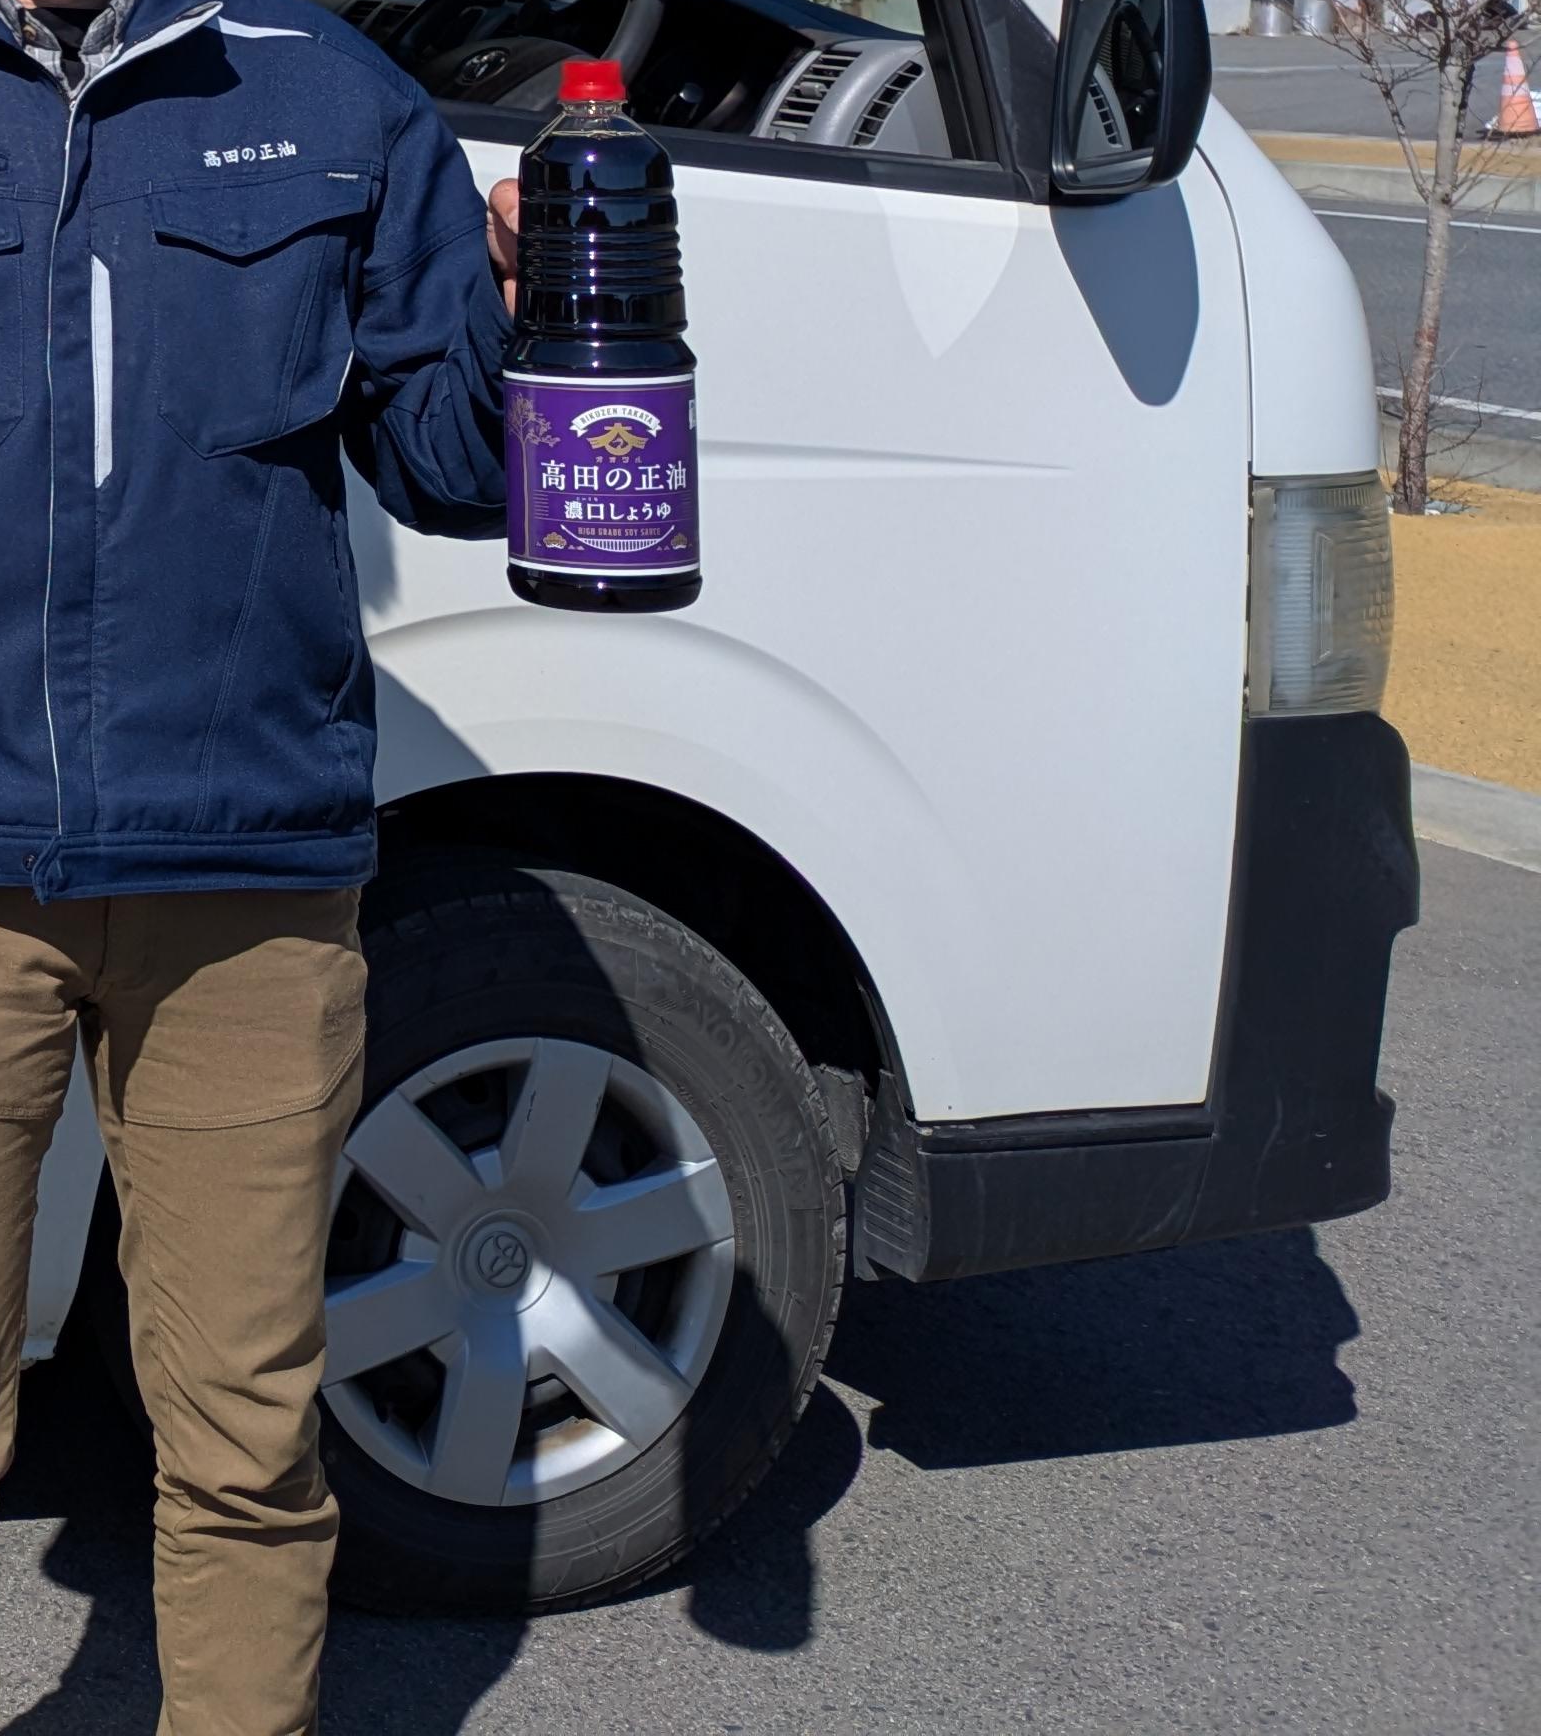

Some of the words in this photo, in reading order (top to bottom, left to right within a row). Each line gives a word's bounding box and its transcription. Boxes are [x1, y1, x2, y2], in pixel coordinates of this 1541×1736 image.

[203, 140, 297, 168] 高田の正油
[579, 407, 618, 425] RIKUZEN
[622, 407, 653, 425] TAKATA
[541, 459, 687, 491] 高田の正油
[564, 500, 671, 521] 濃口しょうゆ
[577, 527, 596, 536] HIGH
[598, 528, 622, 537] GRADE
[624, 528, 638, 537] SOY
[640, 527, 661, 536] SAUCE
